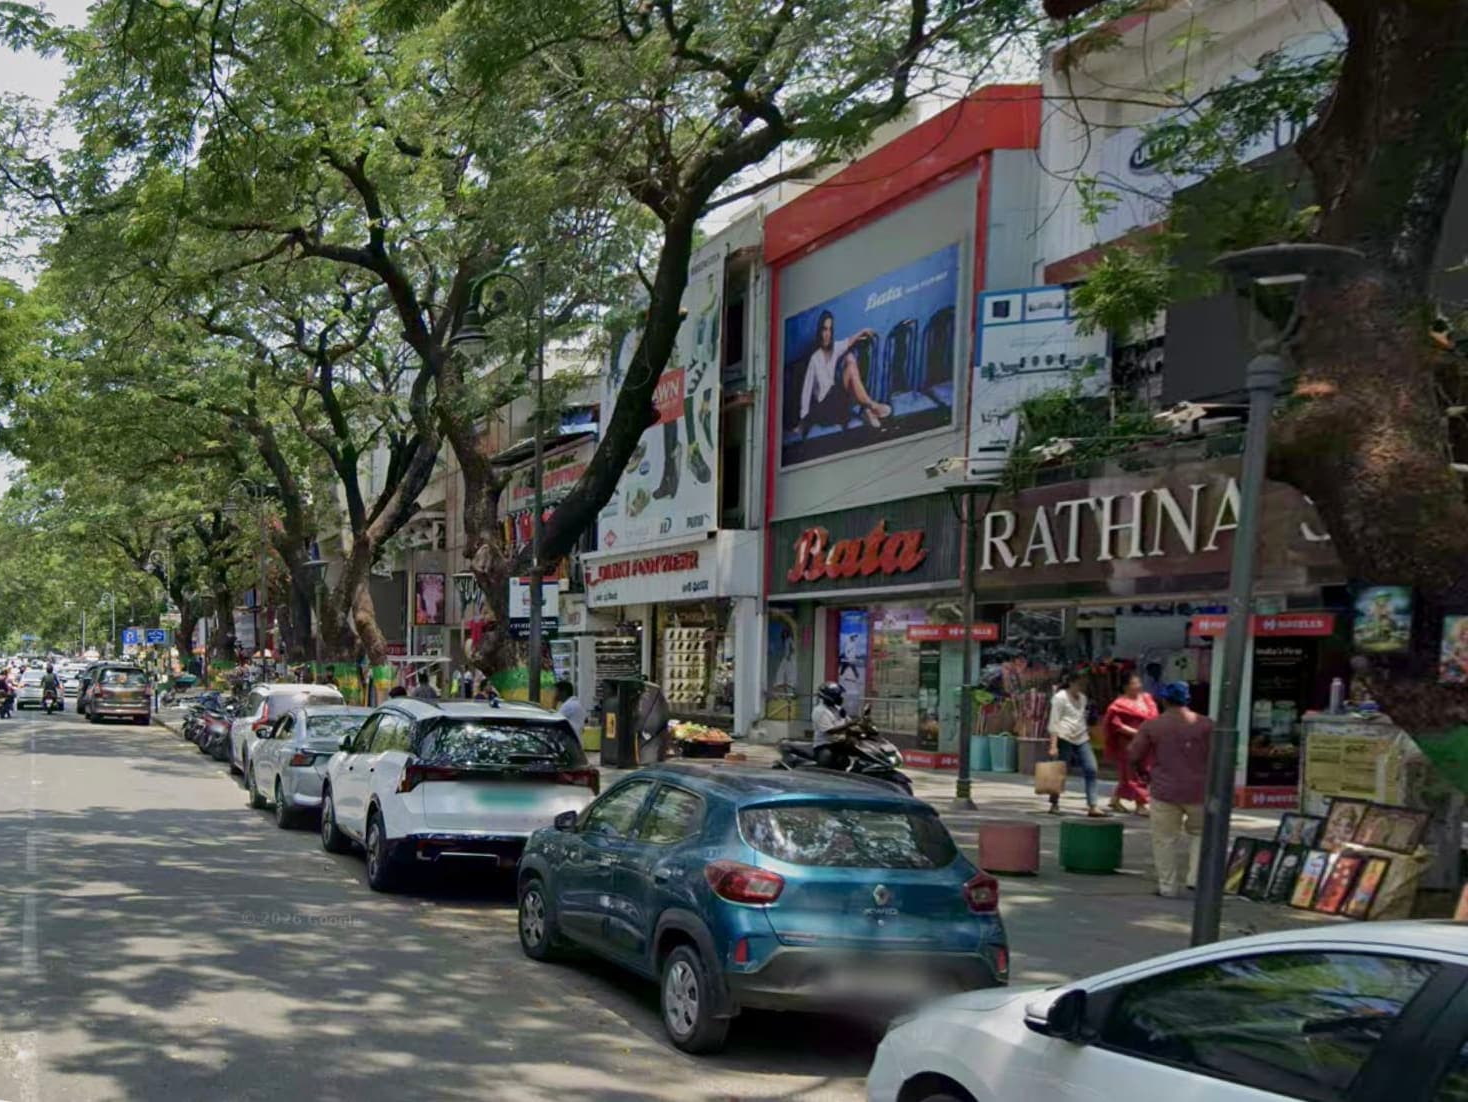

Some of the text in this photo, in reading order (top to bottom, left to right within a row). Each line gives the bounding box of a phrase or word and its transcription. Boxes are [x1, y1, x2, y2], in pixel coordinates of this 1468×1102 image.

[865, 286, 902, 312] Bata
[787, 518, 928, 582] Bata
[980, 477, 1241, 571] RATHNA
